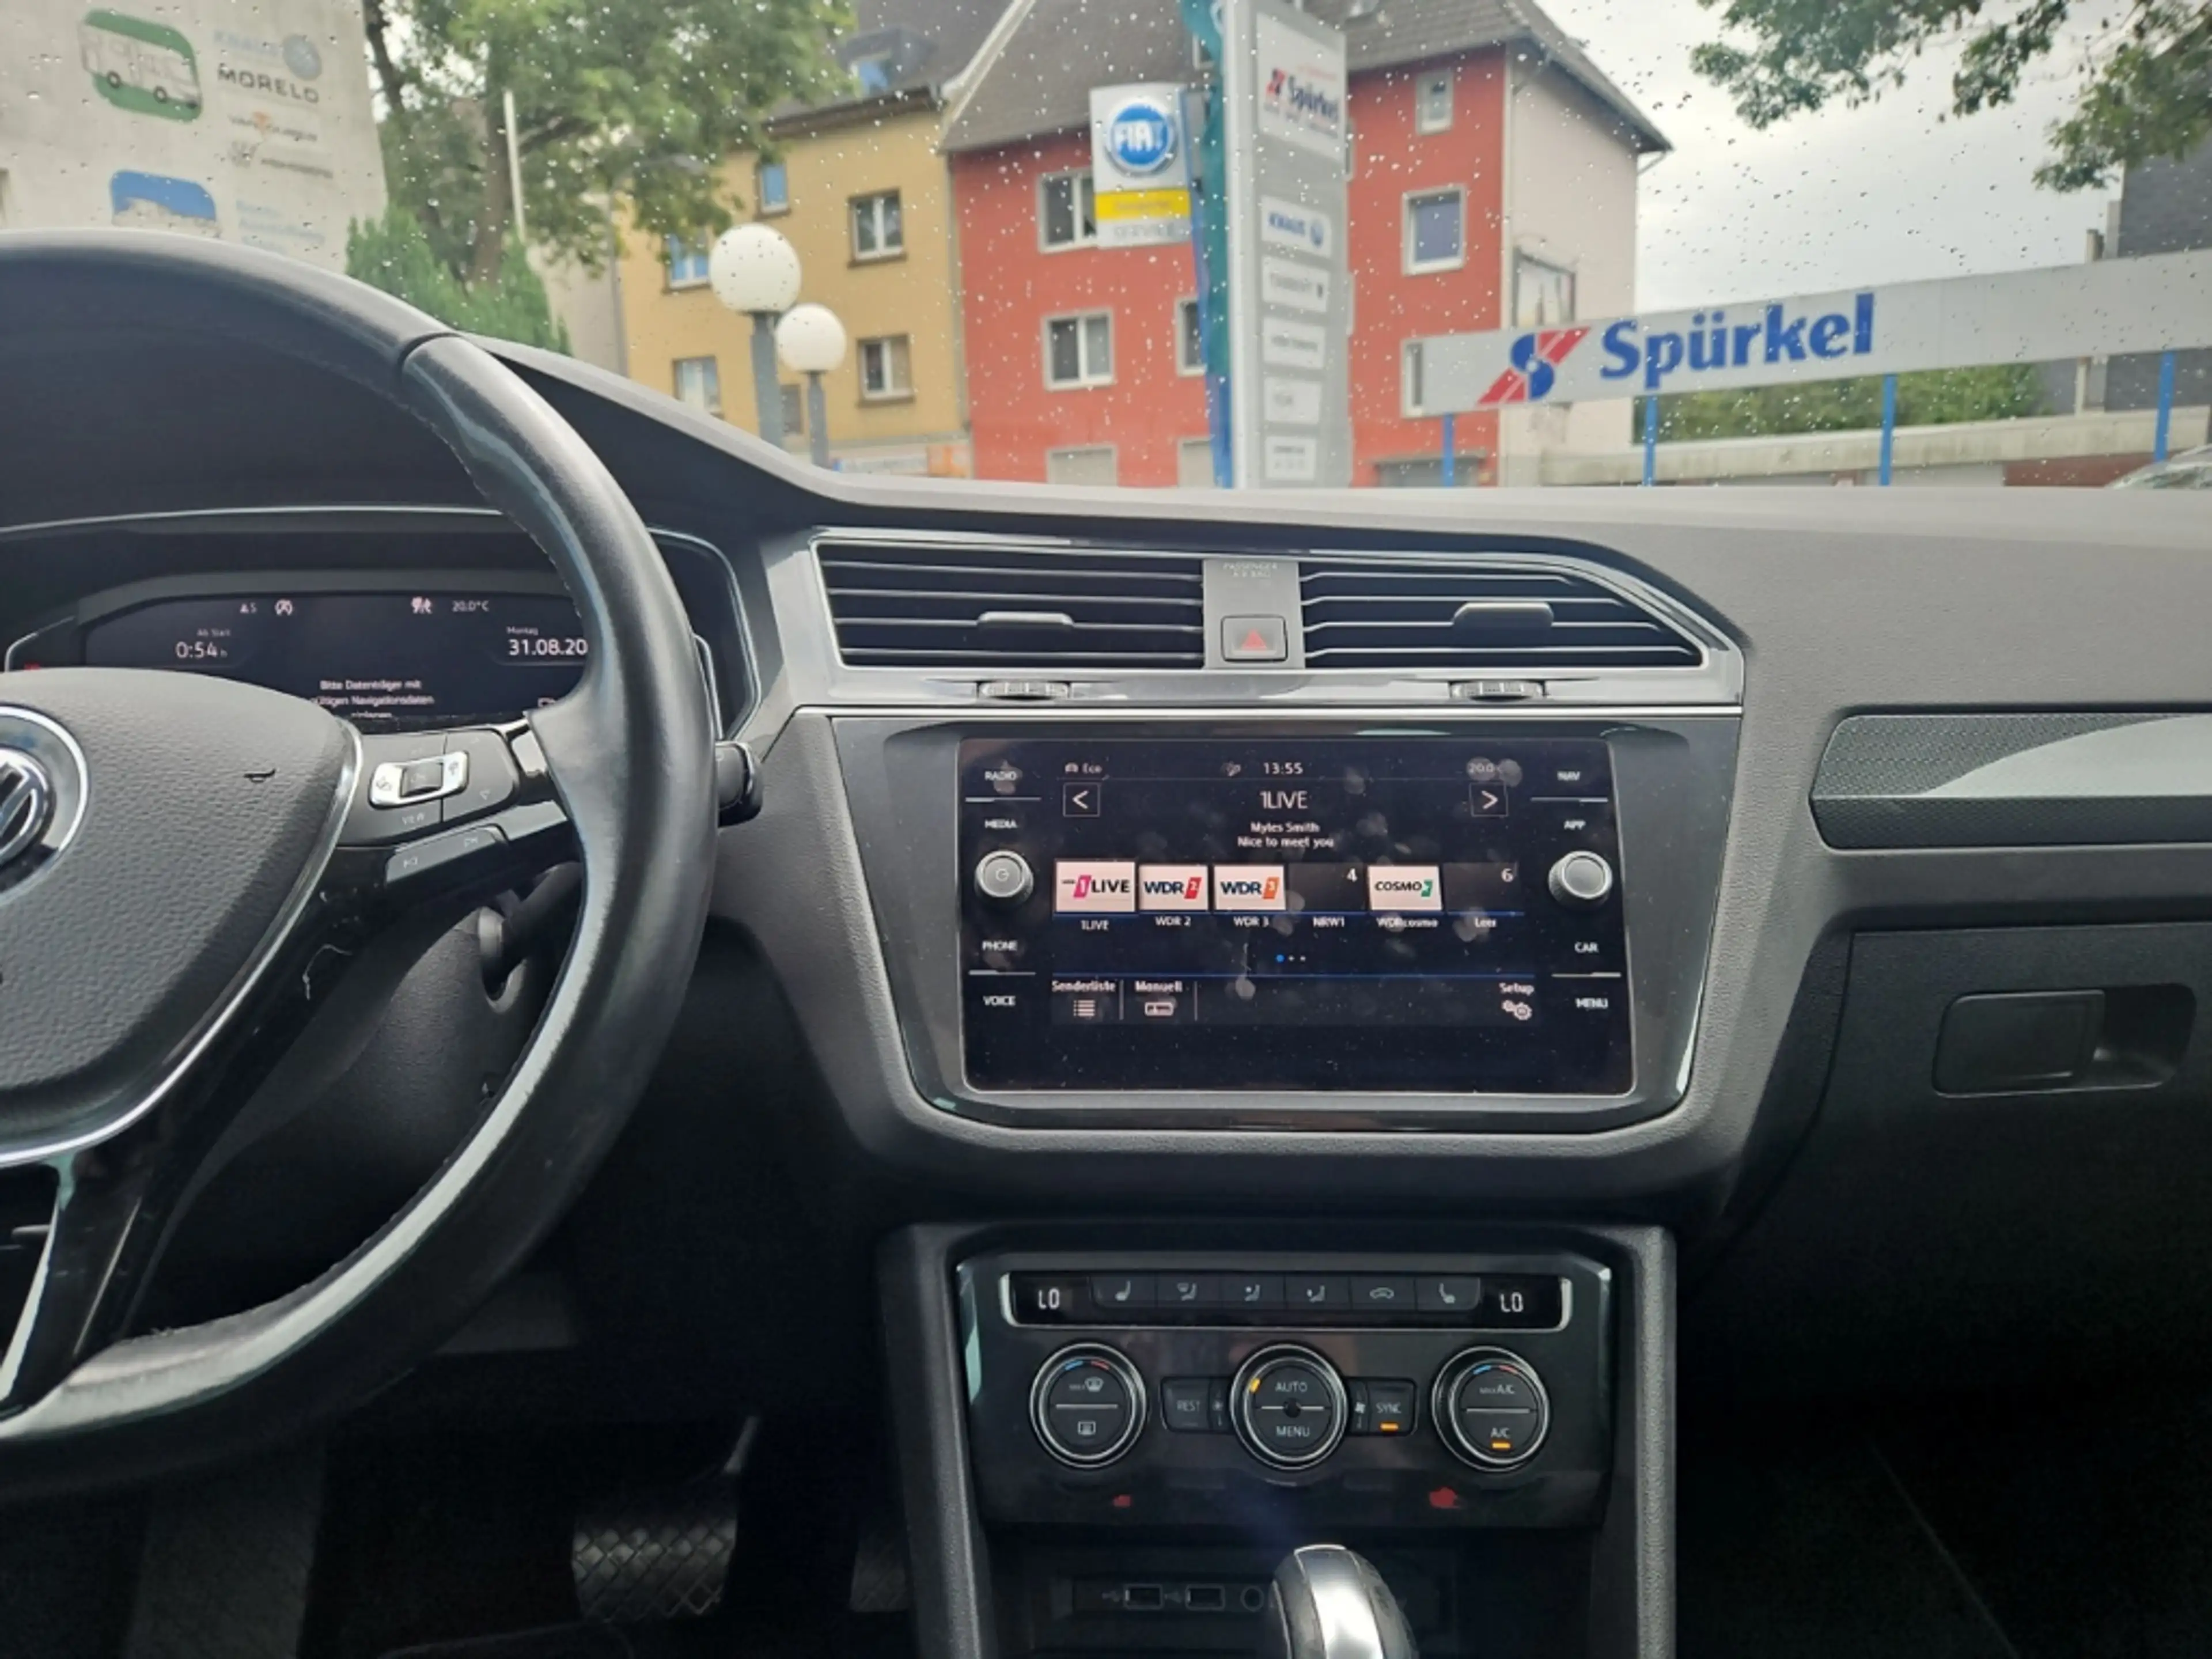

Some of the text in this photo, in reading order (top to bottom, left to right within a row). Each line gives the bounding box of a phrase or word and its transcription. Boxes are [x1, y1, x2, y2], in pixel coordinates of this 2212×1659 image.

[217, 62, 320, 103] MORELO
[1600, 292, 1874, 390] Spürkel
[176, 641, 218, 658] 0:54
[508, 639, 588, 656] 31.08.20
[320, 680, 342, 690] Bitte
[1263, 762, 1304, 775] 13:55
[984, 771, 1017, 781] RADIO
[1259, 790, 1308, 809] 1LIVE
[984, 820, 1017, 829] MEDIA
[1250, 822, 1320, 835] Myles Smith
[1237, 837, 1334, 850] Nice to meet you
[1346, 868, 1358, 882] 4
[1501, 868, 1514, 882] 6
[1144, 881, 1184, 894] WDR
[1221, 881, 1262, 895] WDR
[1374, 881, 1423, 892] COSMO
[1156, 915, 1180, 926] WDR
[1233, 916, 1259, 926] WDR
[982, 941, 1018, 951] PHONE
[1574, 941, 1599, 953] CAR
[1051, 981, 1116, 993] Senderliste
[1135, 981, 1183, 993] Manuell
[1499, 982, 1535, 996] Setup
[983, 995, 1016, 1006] VOICE
[1575, 998, 1608, 1008] MENU
[1038, 1289, 1060, 1309] LO
[1500, 1292, 1524, 1313] LO
[1275, 1382, 1308, 1393] AUTO
[1177, 1400, 1200, 1411] REST
[1376, 1403, 1402, 1414] SYNC
[1276, 1426, 1310, 1437] MENU
[1490, 1427, 1510, 1439] A/C
